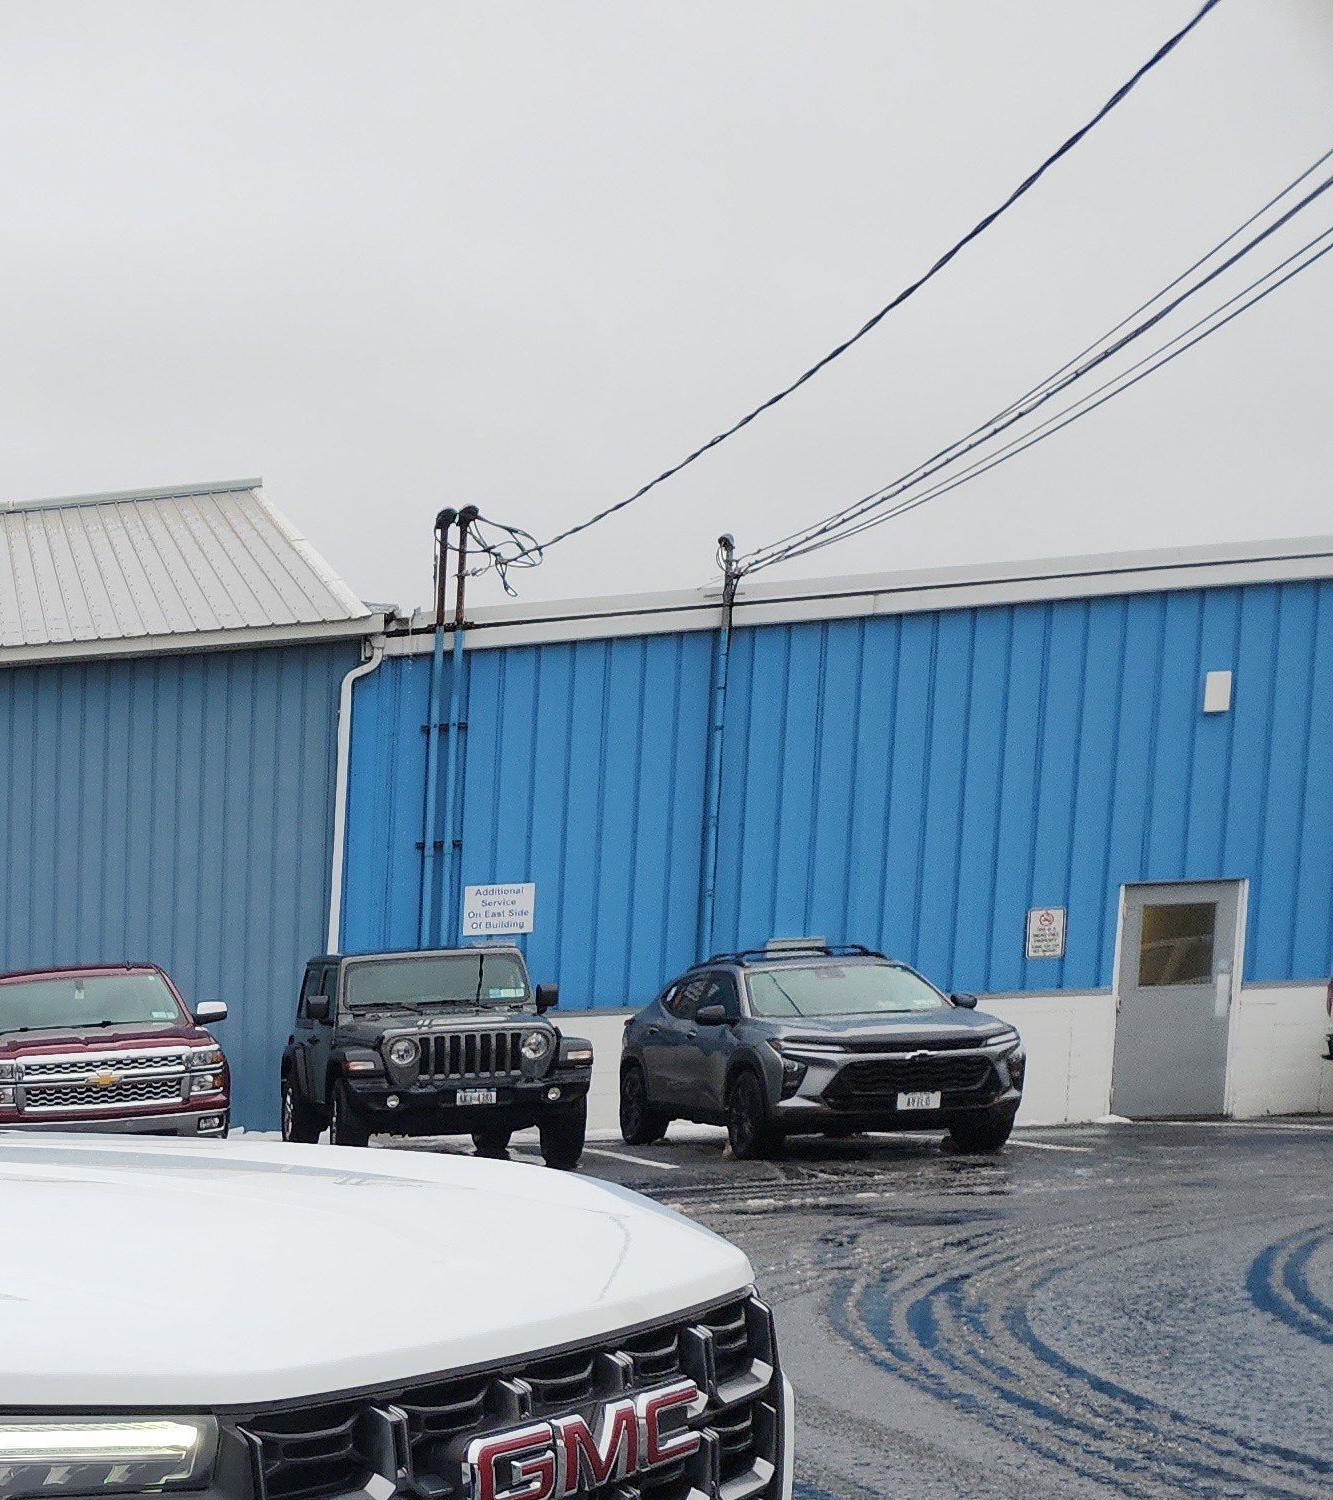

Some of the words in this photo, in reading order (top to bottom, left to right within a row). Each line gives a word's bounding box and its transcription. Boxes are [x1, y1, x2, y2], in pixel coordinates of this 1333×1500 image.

[475, 886, 524, 897] Additional
[481, 899, 516, 908] Service
[468, 911, 481, 919] On
[484, 909, 505, 919] East
[508, 908, 529, 917] Side
[471, 921, 482, 930] Of
[485, 921, 525, 929] Building
